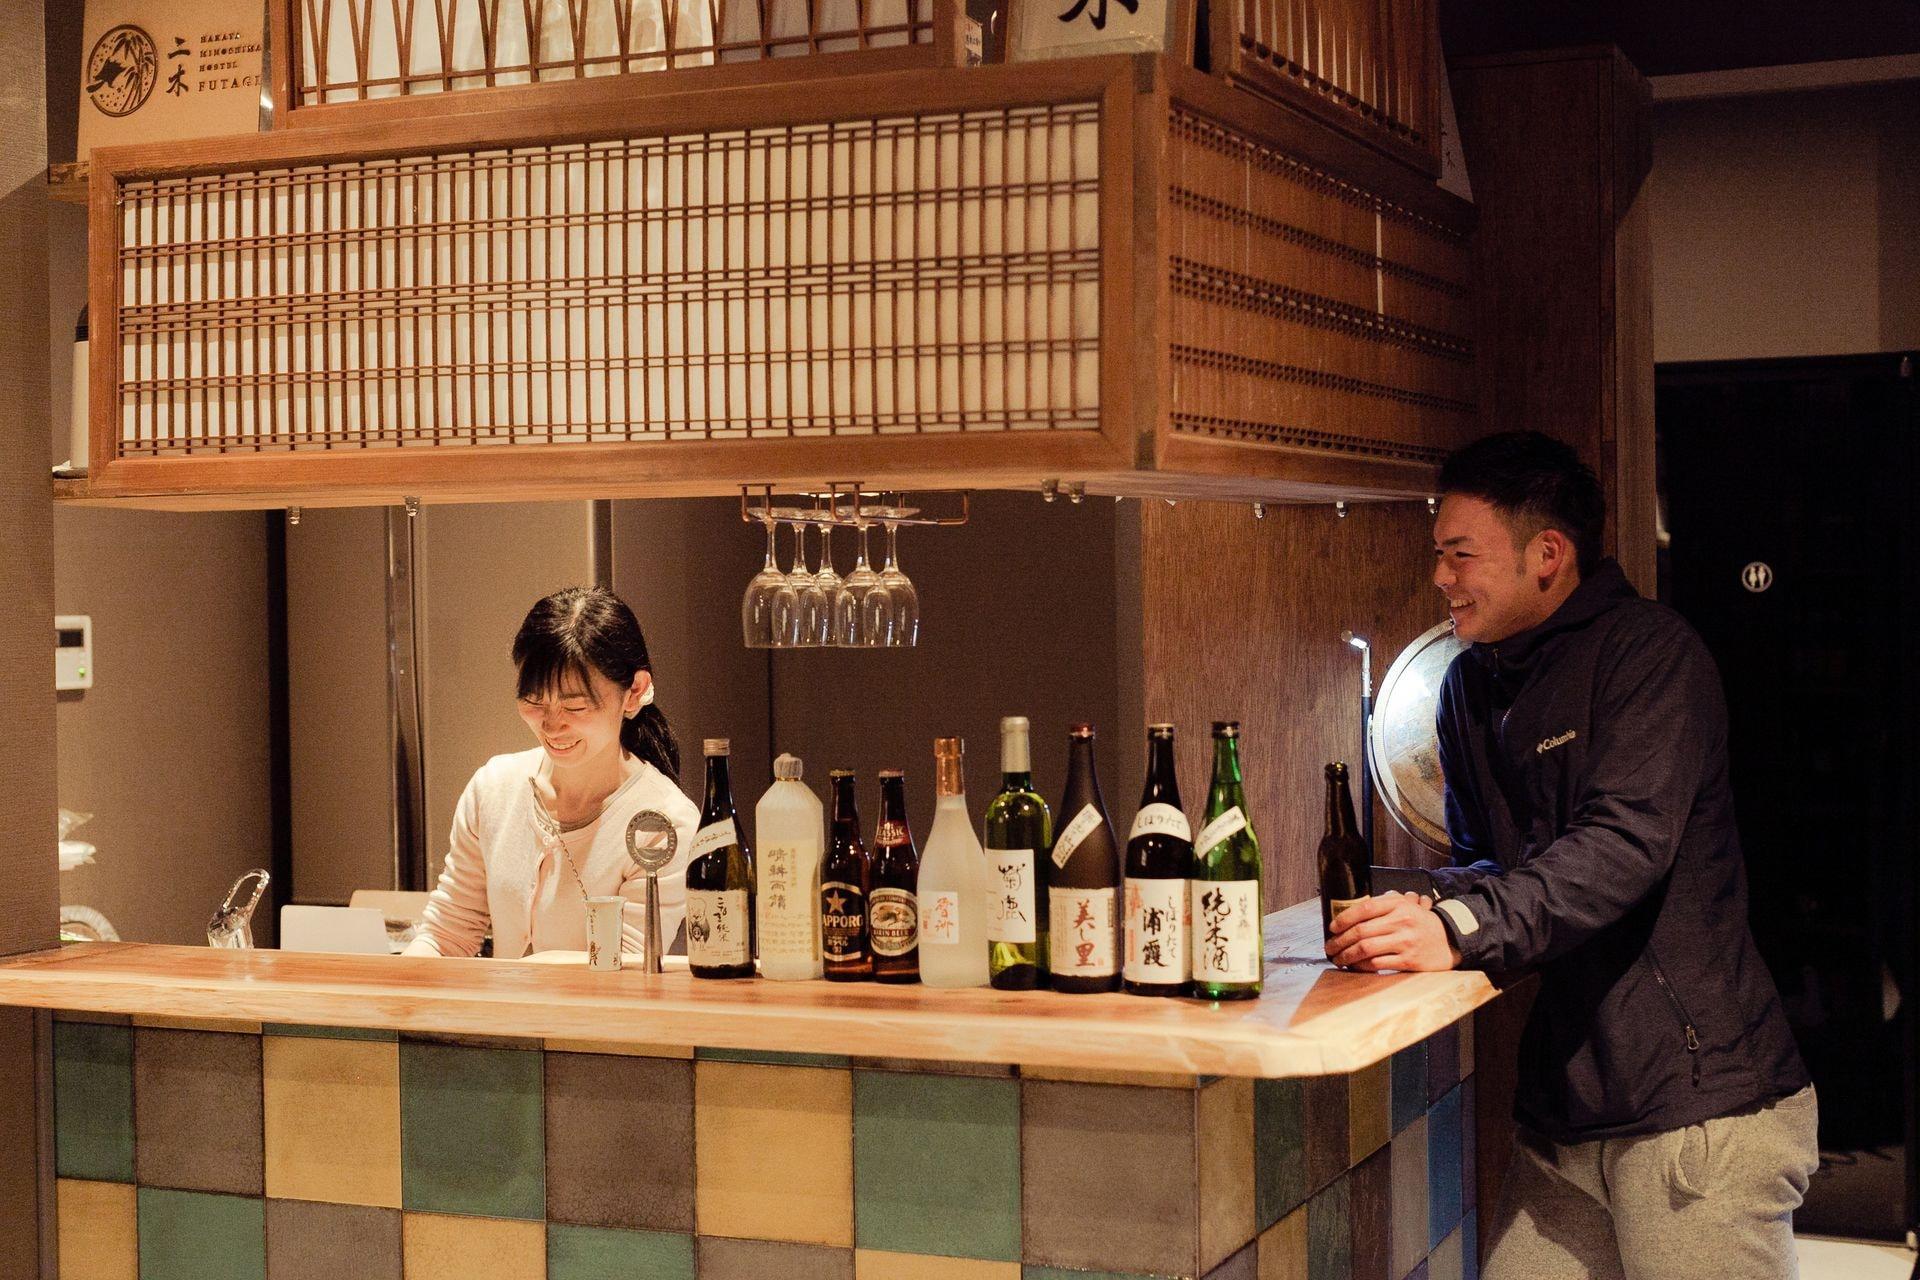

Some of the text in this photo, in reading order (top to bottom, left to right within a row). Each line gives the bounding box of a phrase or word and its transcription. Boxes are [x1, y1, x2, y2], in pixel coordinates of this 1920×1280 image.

[166, 36, 191, 97] 二木
[199, 61, 239, 72] HOSTEL
[200, 32, 241, 44] HAKATA
[1543, 730, 1576, 750] Columbia
[1073, 899, 1096, 967] 美し里
[1142, 907, 1169, 968] 浦霞
[1201, 887, 1231, 973] 純米酒
